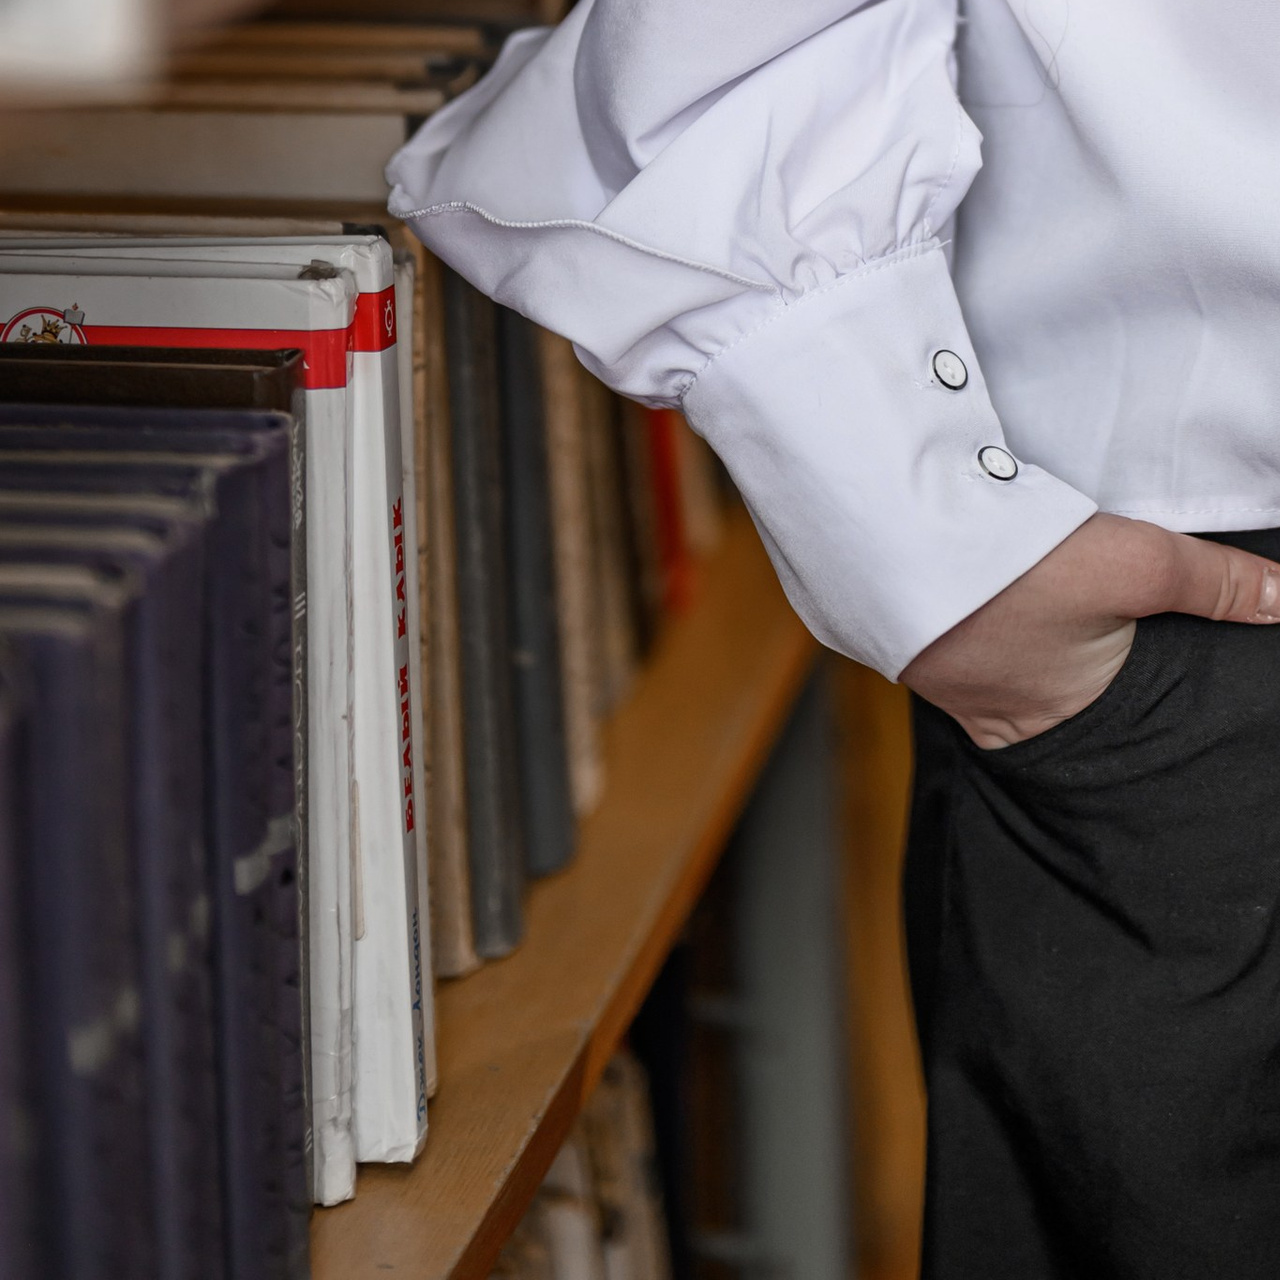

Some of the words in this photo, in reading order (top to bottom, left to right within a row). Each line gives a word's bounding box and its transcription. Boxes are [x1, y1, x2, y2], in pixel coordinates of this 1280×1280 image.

[392, 496, 406, 639] КЛЫК
[397, 664, 414, 833] БЕЛЫЙ
[411, 906, 424, 1021] Лондон
[416, 1028, 427, 1122] Джек
